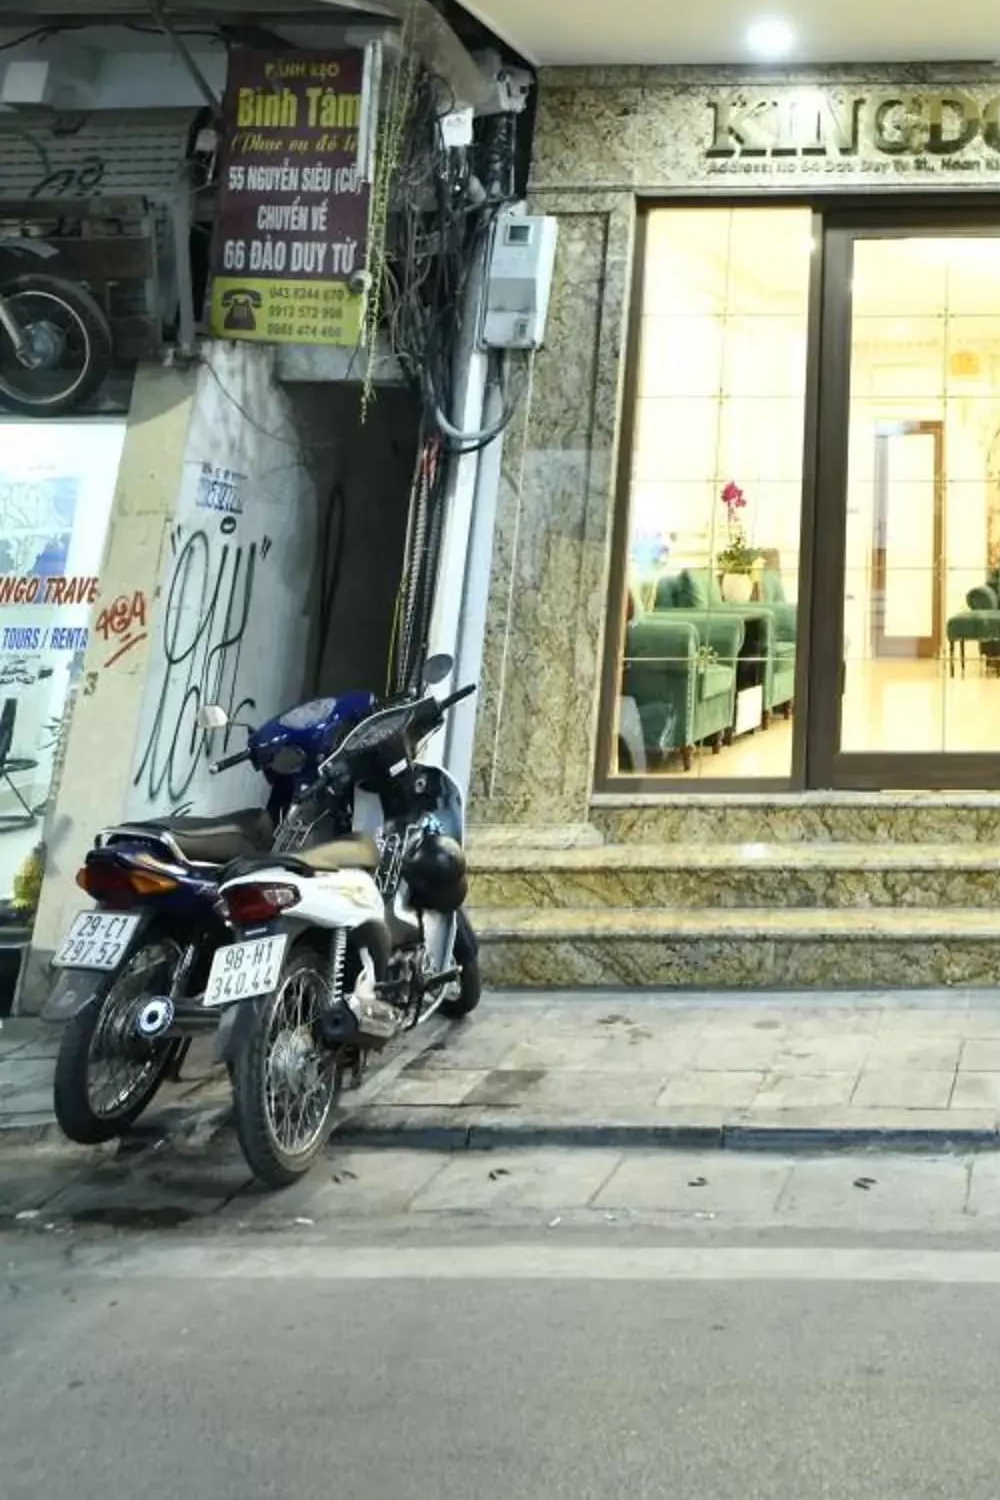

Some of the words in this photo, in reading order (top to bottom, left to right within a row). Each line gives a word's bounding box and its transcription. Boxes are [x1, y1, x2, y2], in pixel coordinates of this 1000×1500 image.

[228, 165, 245, 190] 55
[223, 240, 246, 269] 66
[290, 242, 329, 273] DUY
[44, 577, 99, 605] TRAVE
[3, 628, 40, 649] TOURS
[77, 916, 129, 939] 29-C1
[60, 940, 121, 965] 297.52
[224, 941, 274, 973] 98-H1
[212, 966, 273, 1000] 340.44
